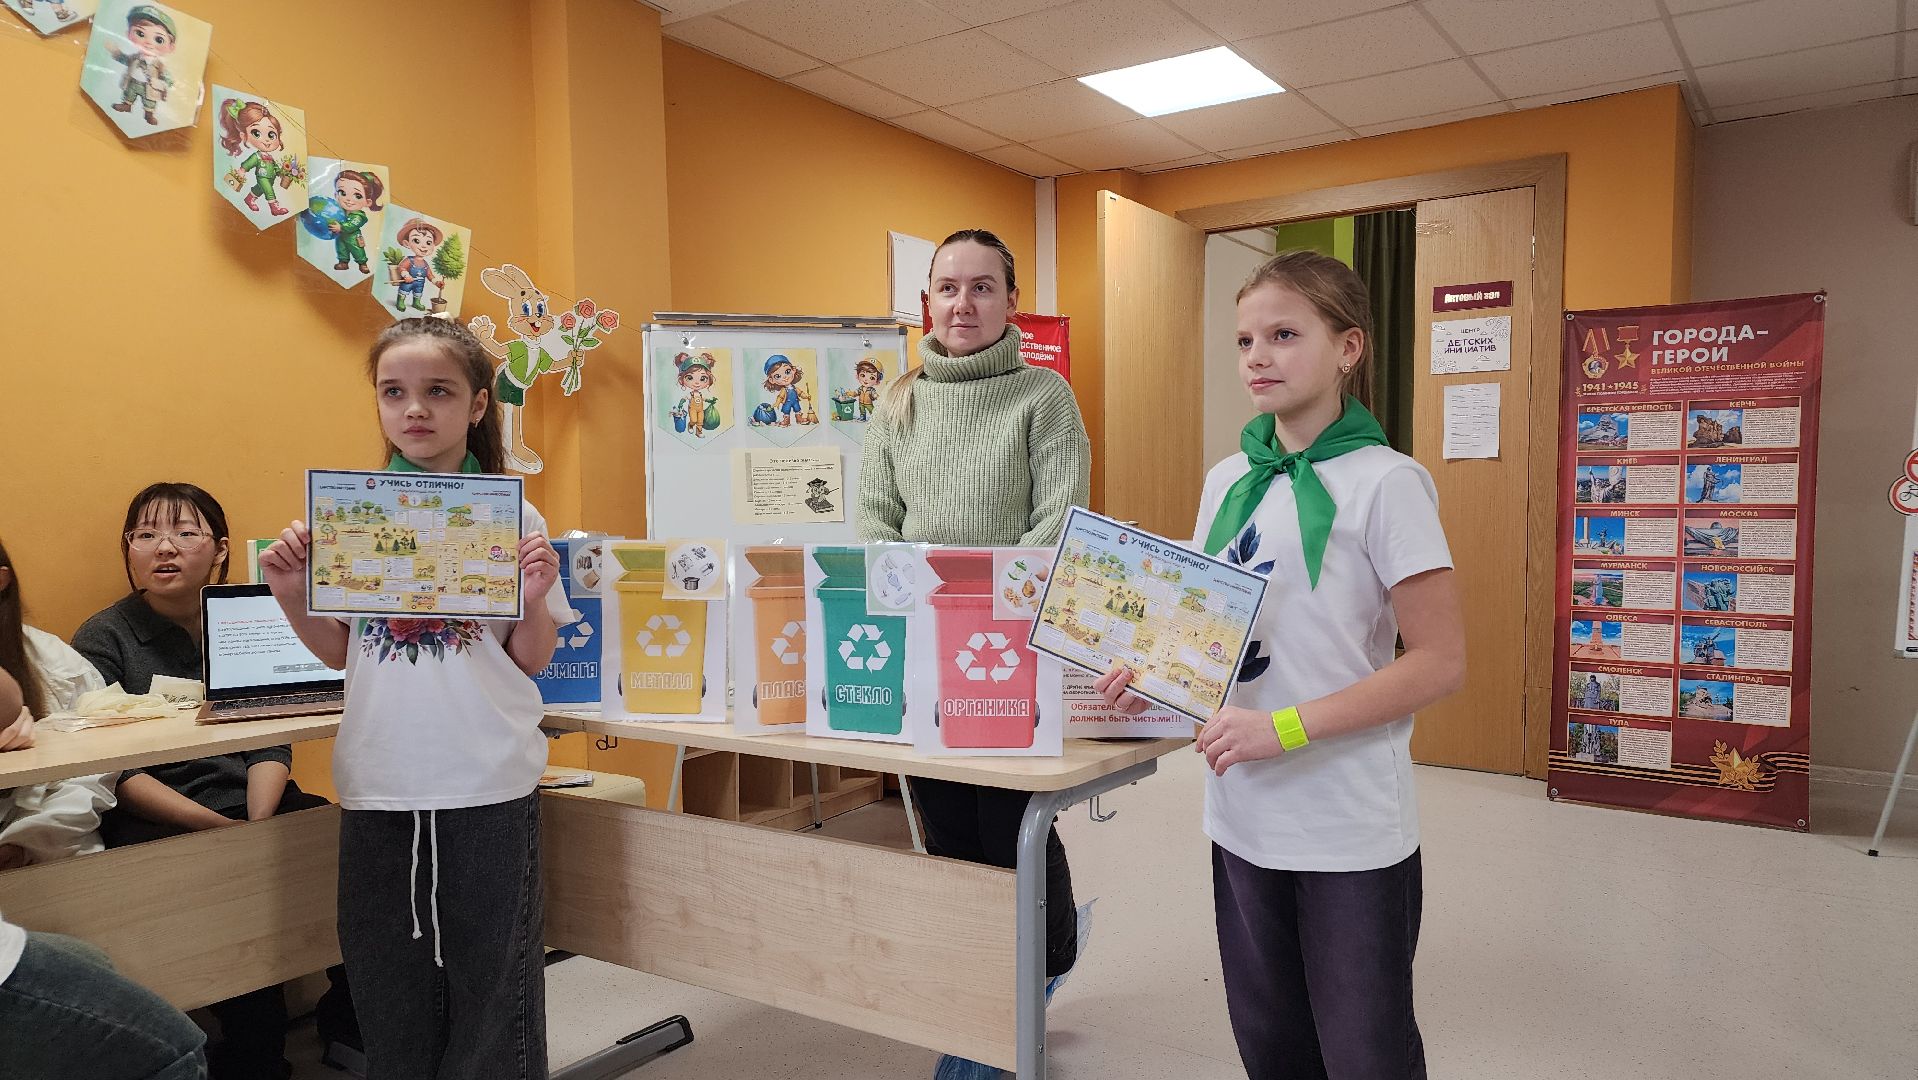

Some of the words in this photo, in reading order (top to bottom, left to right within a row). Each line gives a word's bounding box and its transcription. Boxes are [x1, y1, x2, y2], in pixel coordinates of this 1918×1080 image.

[1020, 341, 1062, 353] рственное
[1447, 337, 1493, 347] ДЕТСКИХ
[1444, 345, 1497, 354] ИНИЦИАТИВ
[1652, 346, 1728, 366] ГЕРОИ
[1651, 365, 1692, 375] ВЕЛИКОЙ
[1694, 362, 1767, 372] ОТЕЧЕСТВЕННОЙ
[1769, 359, 1804, 369] ВОЙНЫ
[1582, 382, 1606, 392] 1941
[1613, 381, 1639, 391] 1945
[1586, 405, 1630, 413] БРЕСТСКАЯ
[1631, 403, 1674, 411] КРЕПОСТЬ
[1729, 400, 1757, 408] КЕРЧЬ
[1616, 457, 1638, 465] КИЕВ
[1715, 456, 1768, 464] ЛЕНИНГРАД
[379, 479, 412, 487] УЧИСЬ
[415, 480, 465, 490] ОТЛИЧНО!
[1719, 510, 1759, 518] МОСКВА
[1131, 537, 1160, 553] УЧИСЬ
[1163, 549, 1210, 572] ОТЛИЧНО!
[1600, 561, 1648, 570] МУРМАНСК
[1701, 563, 1775, 573] НОВОРОССИЙСК
[1606, 613, 1639, 623] ОДЕССА
[1704, 618, 1769, 629] СЕВАСТОПОЛЬ
[1598, 665, 1643, 675] СМОЛЕНСК
[630, 672, 693, 690] МЕТАЛЛ
[1706, 672, 1764, 684] СТАЛИНГРАД
[761, 680, 806, 700] ПЛАС
[835, 684, 892, 706] СТЕКЛО
[943, 698, 1030, 717] ОРГАНИКА
[1069, 715, 1107, 724] должны
[1108, 714, 1130, 723] быть
[1608, 718, 1630, 727] ТУЛА
